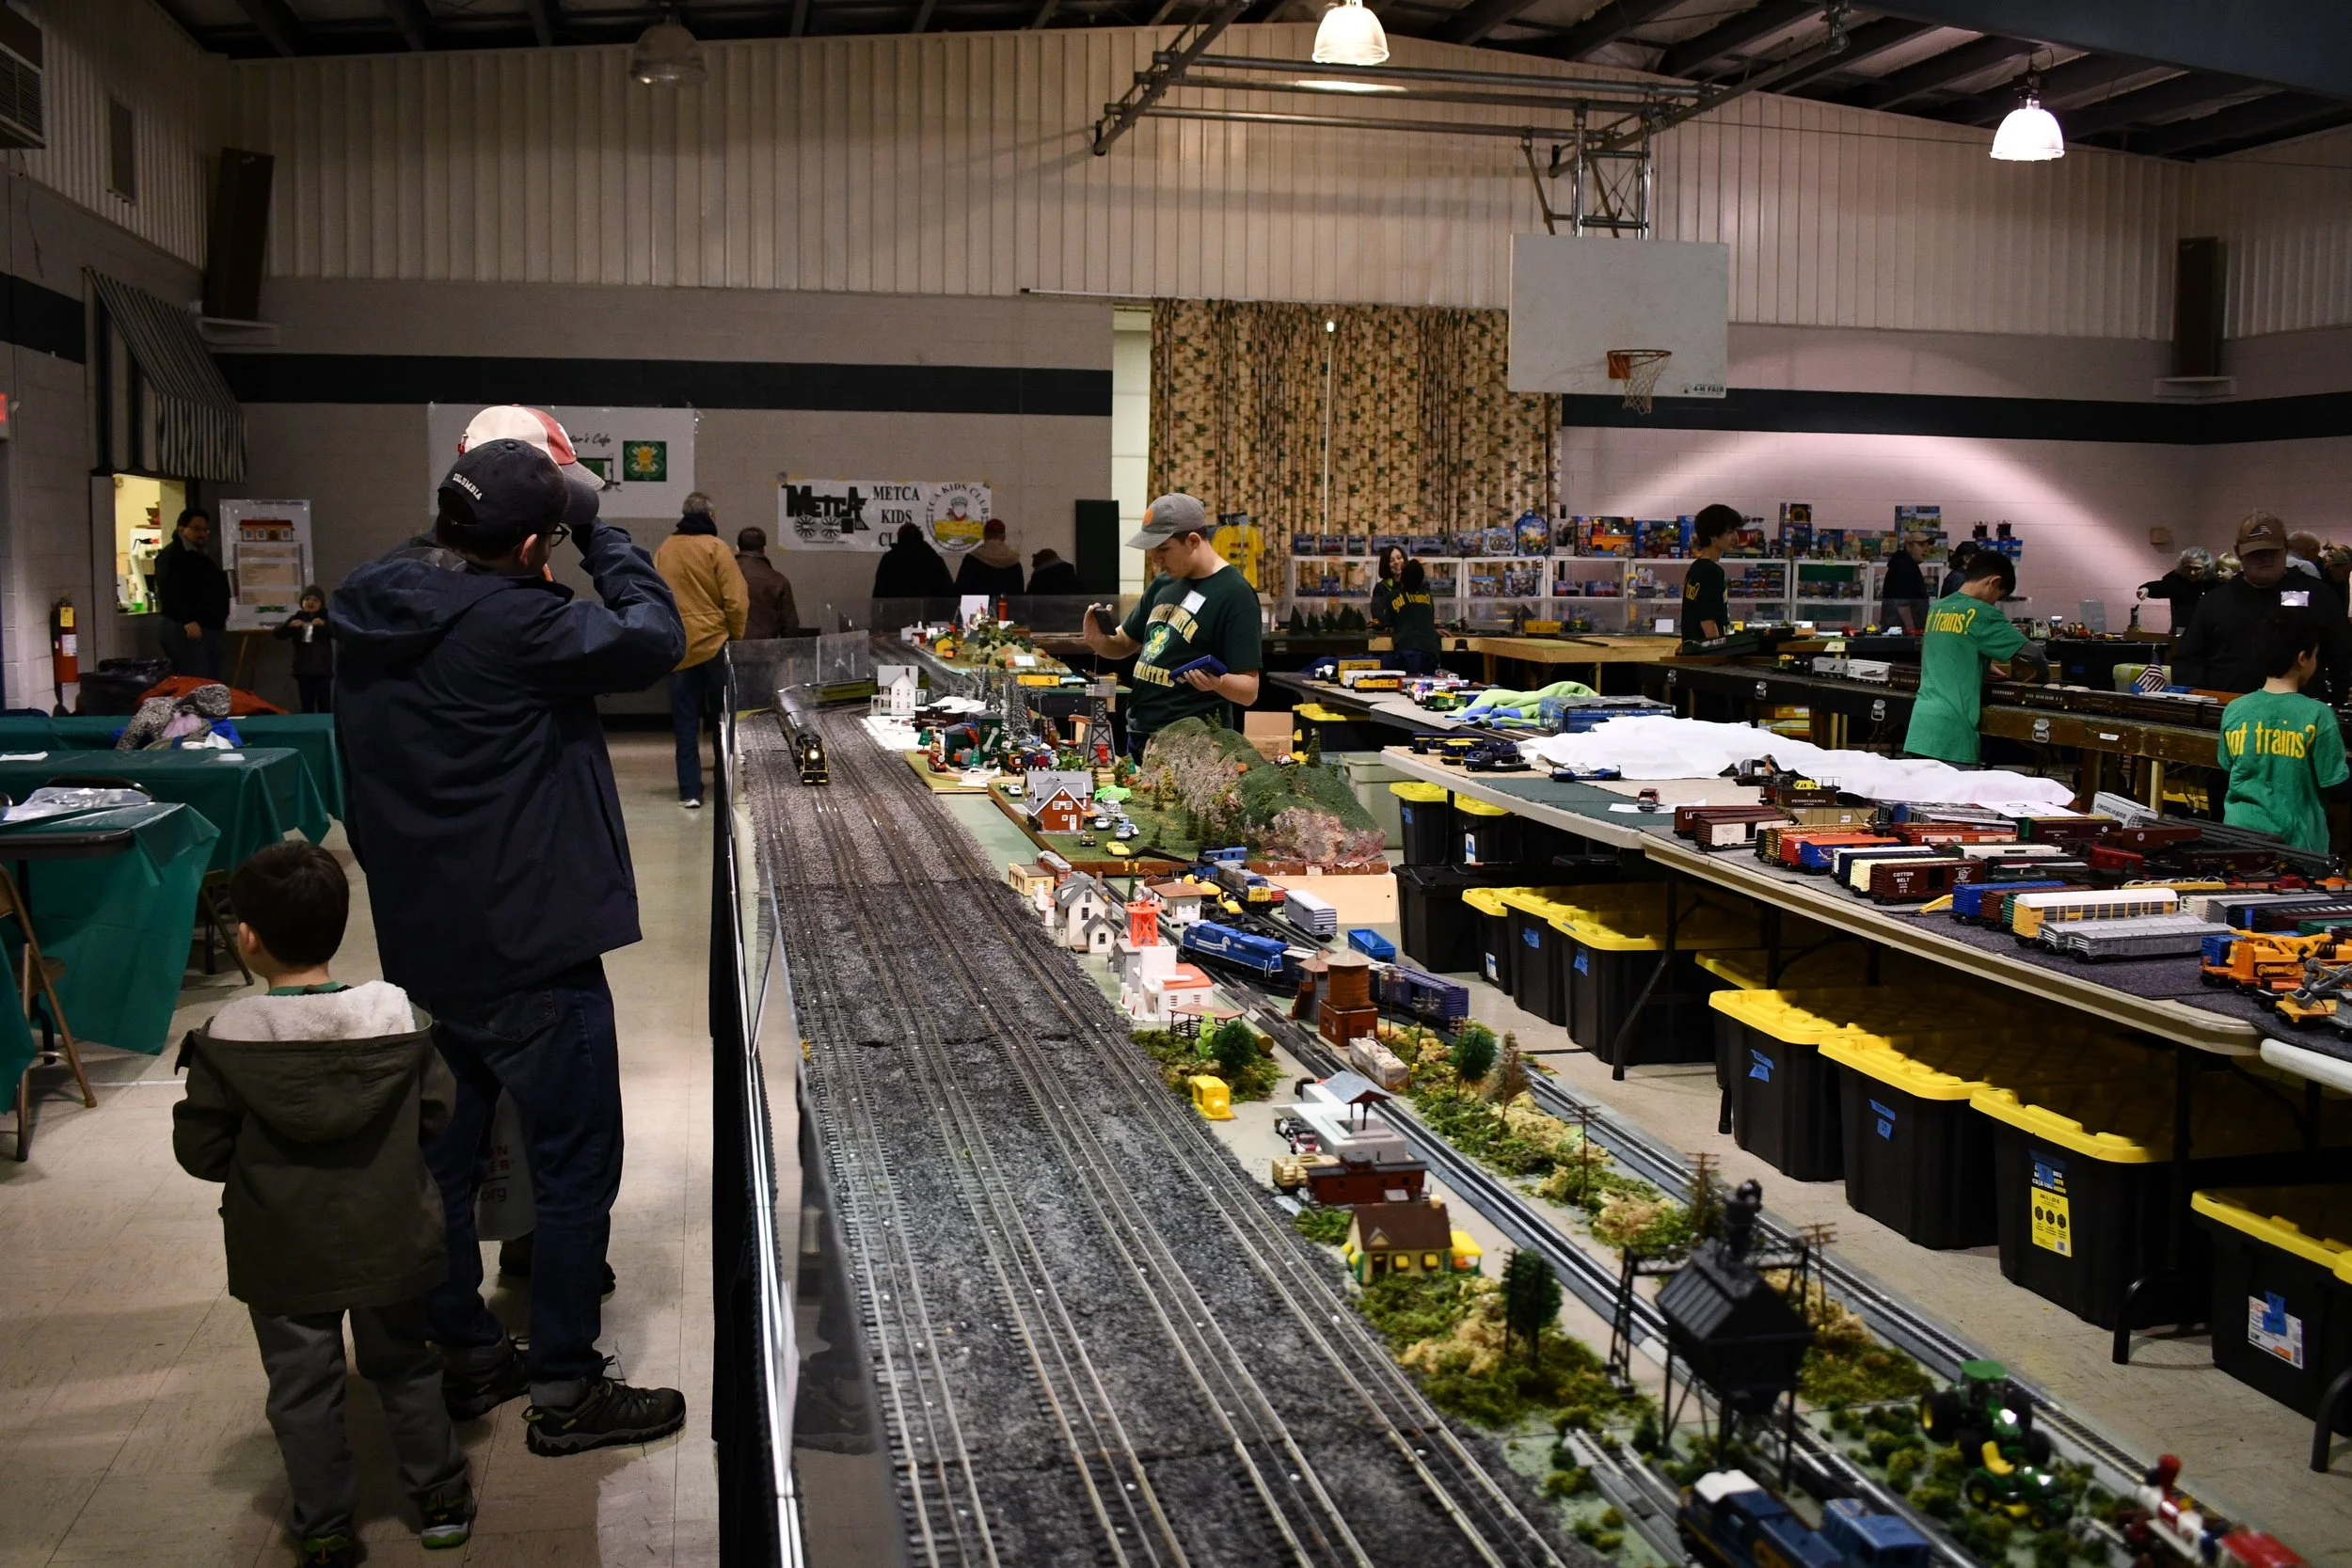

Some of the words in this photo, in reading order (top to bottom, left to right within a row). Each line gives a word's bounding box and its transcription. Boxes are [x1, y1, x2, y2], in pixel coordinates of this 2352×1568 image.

[452, 472, 483, 500] COLUMBIA
[872, 485, 920, 501] METCA
[941, 483, 967, 494] KIDS
[969, 487, 989, 514] CLUB
[881, 509, 913, 524] KIDS
[878, 531, 895, 547] CL
[1392, 593, 1406, 612] got
[1931, 606, 1976, 635] trains?
[2255, 720, 2316, 759] trains?
